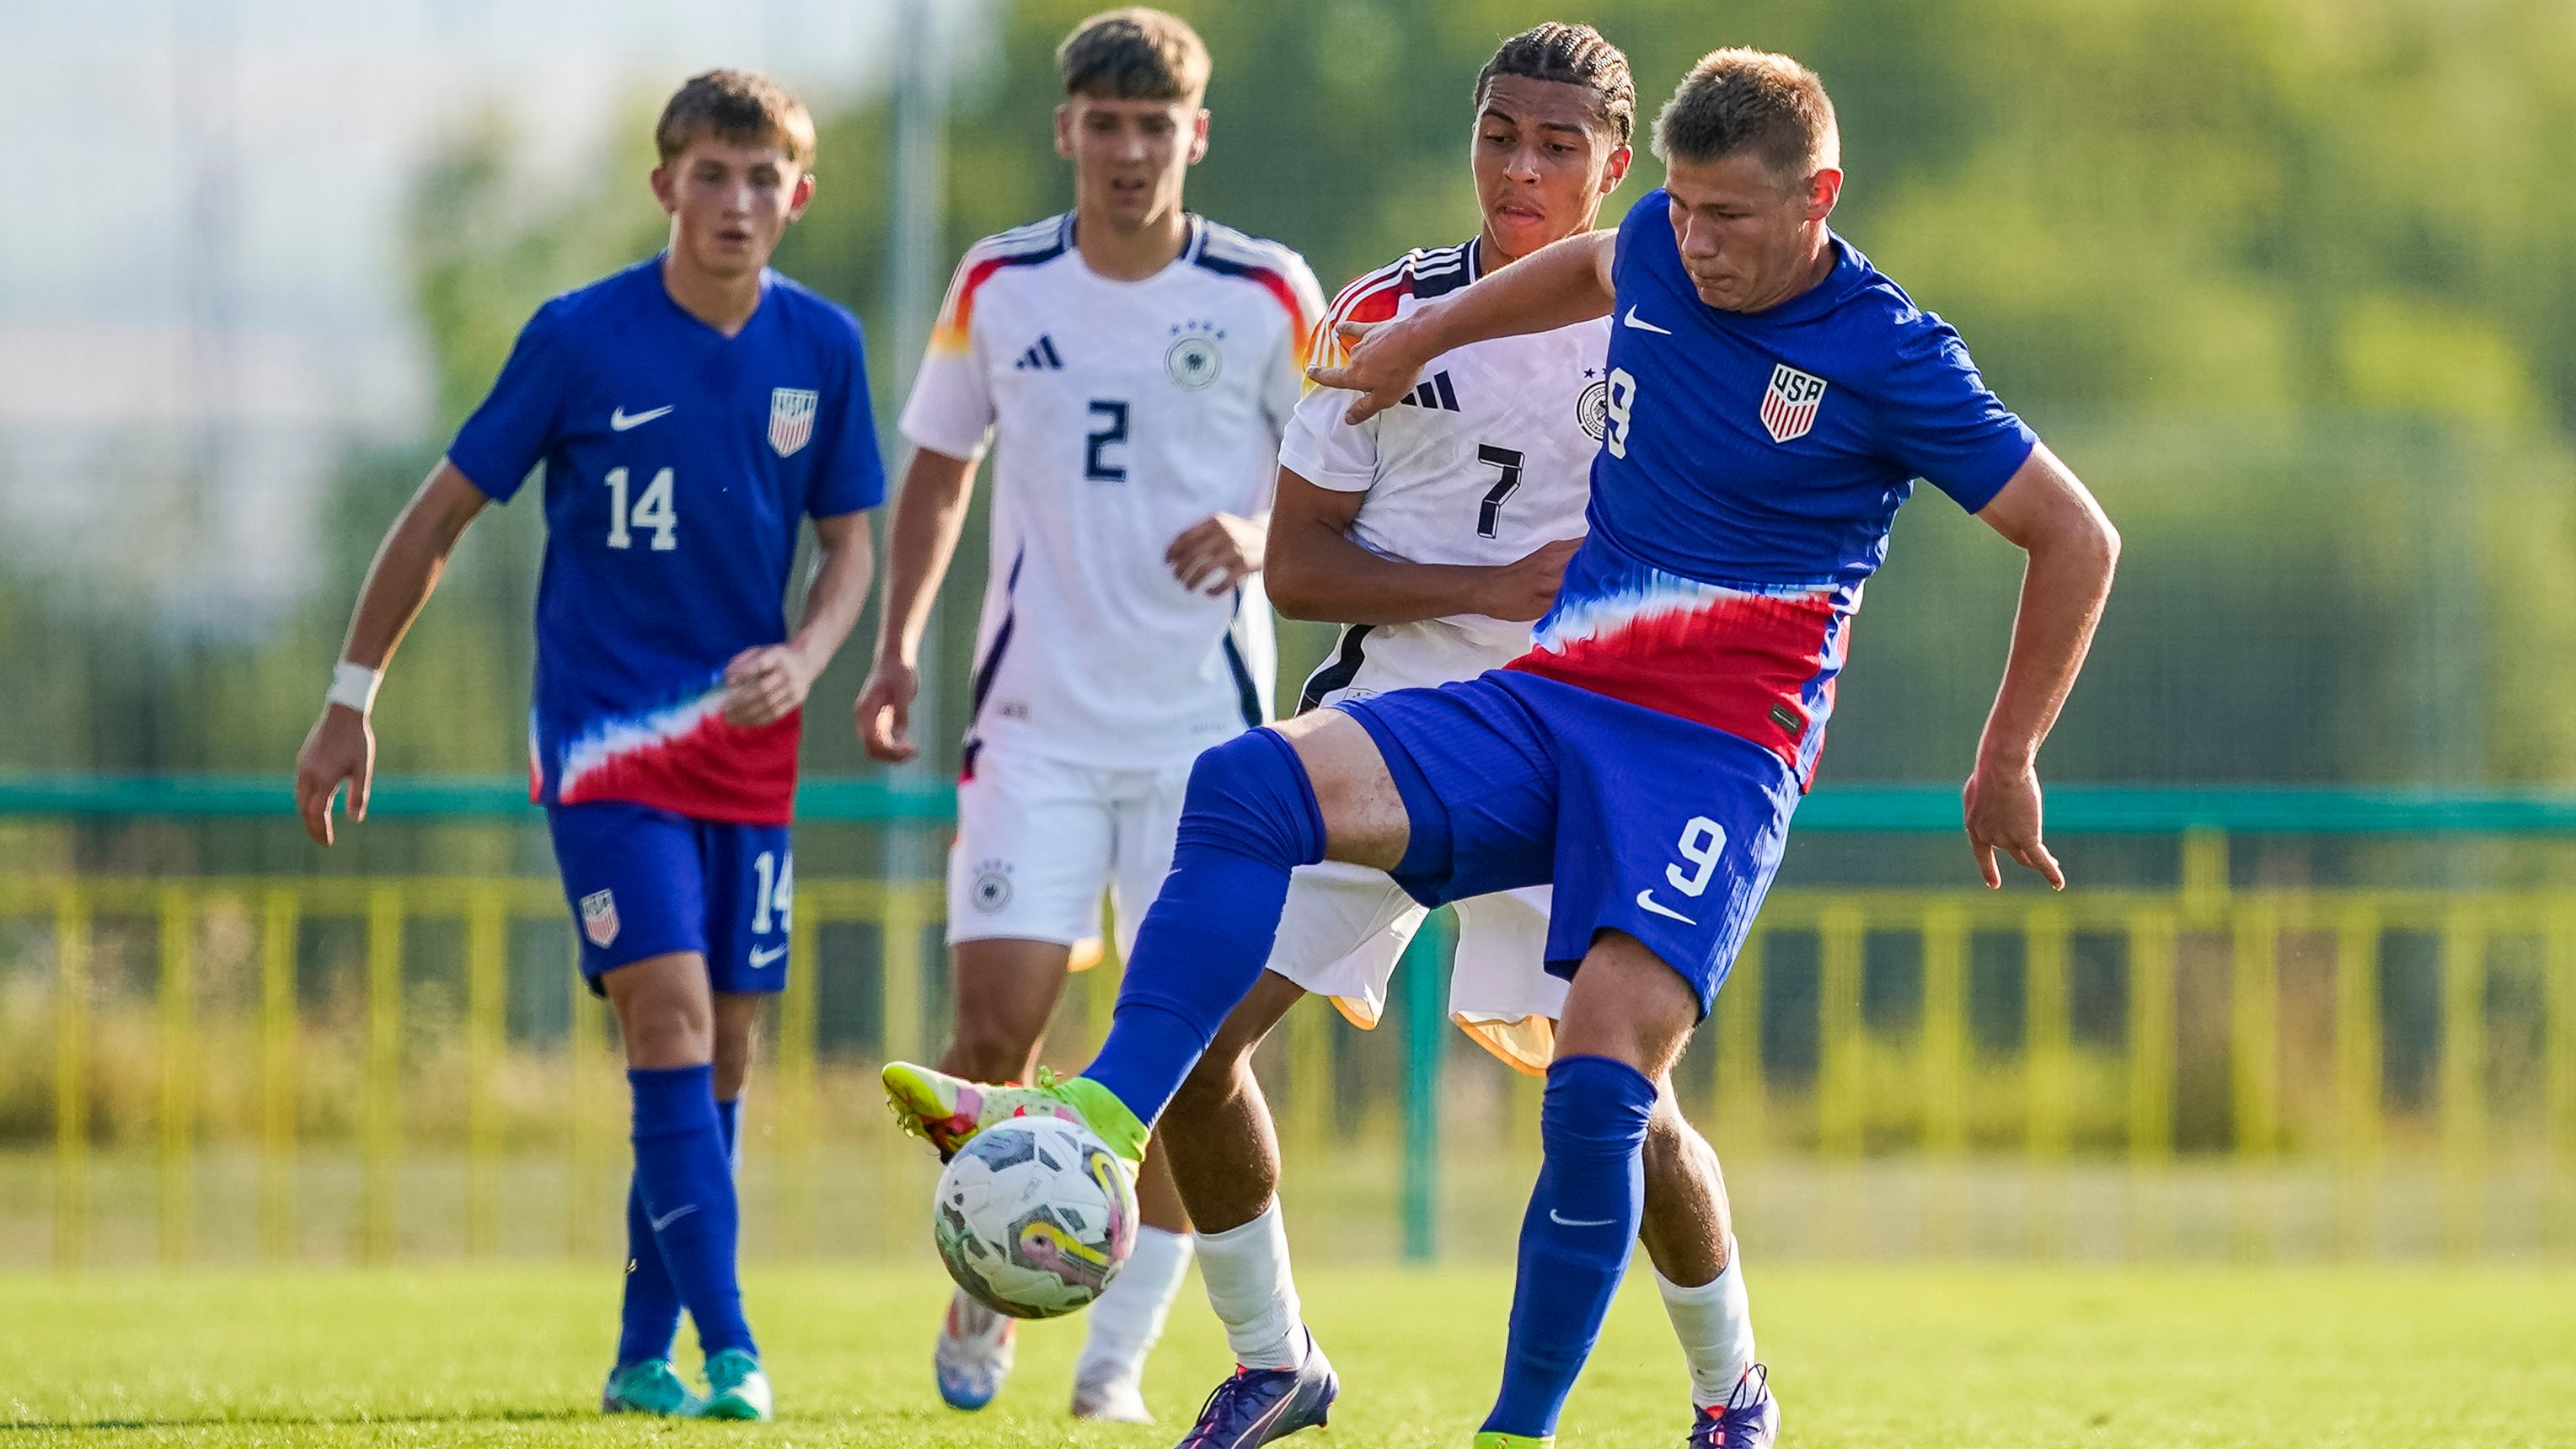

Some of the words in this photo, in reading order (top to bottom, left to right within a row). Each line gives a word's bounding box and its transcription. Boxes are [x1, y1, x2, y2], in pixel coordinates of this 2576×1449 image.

[1607, 366, 1636, 460] 9
[1774, 368, 1824, 403] USA
[1084, 398, 1130, 483] 2
[604, 467, 677, 551] 14
[1477, 444, 1524, 539] 7
[752, 848, 794, 934] 14
[1665, 815, 1727, 898] 9
